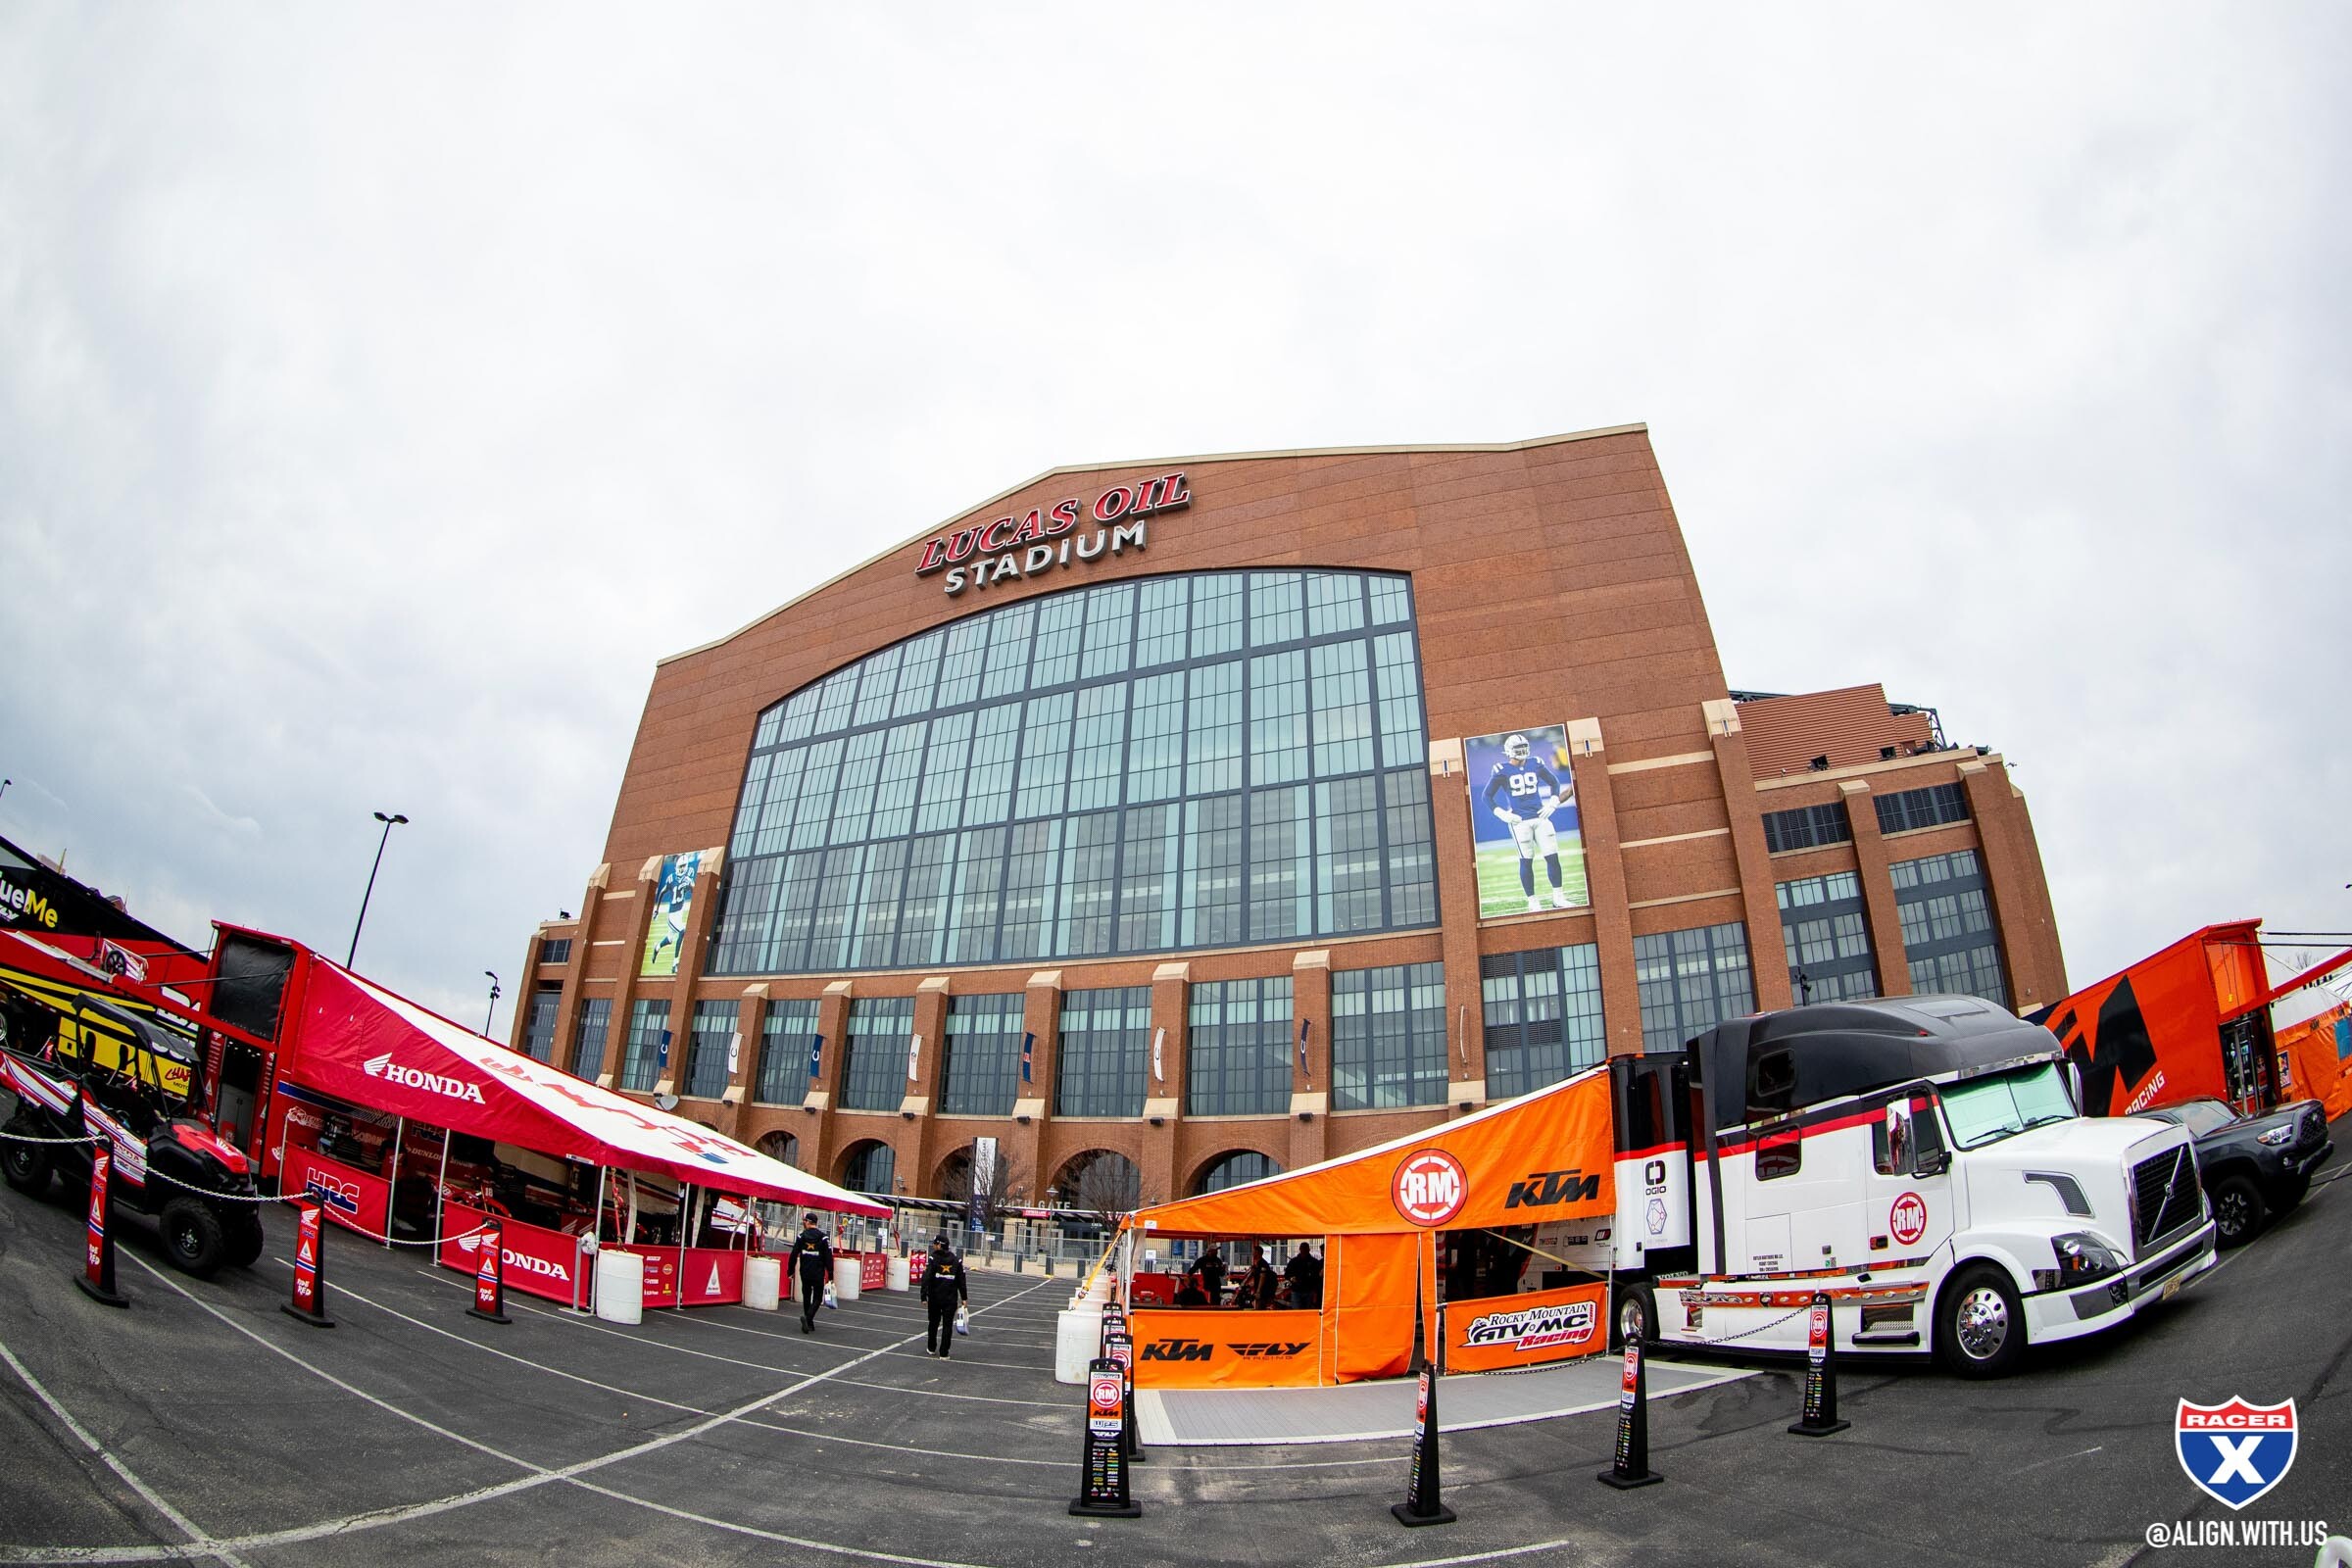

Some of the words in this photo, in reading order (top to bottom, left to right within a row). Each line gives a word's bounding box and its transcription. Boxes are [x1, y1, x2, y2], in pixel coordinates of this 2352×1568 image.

[915, 498, 1081, 576] LUCAS
[1093, 471, 1192, 524] OIL
[944, 520, 1147, 596] STADIUM
[1509, 772, 1539, 797] 99
[384, 1062, 486, 1104] HONDA
[306, 1166, 361, 1214] HRC
[1408, 1171, 1452, 1204] RM
[1504, 1169, 1600, 1209] KTM
[1645, 1186, 1667, 1196] OGIO
[1039, 1200, 1071, 1210] GATE
[1896, 1206, 1920, 1231] RM
[501, 1249, 569, 1282] ONDA
[298, 1286, 312, 1296] RED
[1491, 1313, 1527, 1326] ROCKY
[1529, 1303, 1588, 1321] MOUNTAIN
[1473, 1323, 1530, 1344] ATV
[1535, 1313, 1589, 1334] MC
[1520, 1328, 1592, 1348] Racing
[1140, 1339, 1214, 1361] KTM
[1226, 1343, 1312, 1355] FLY
